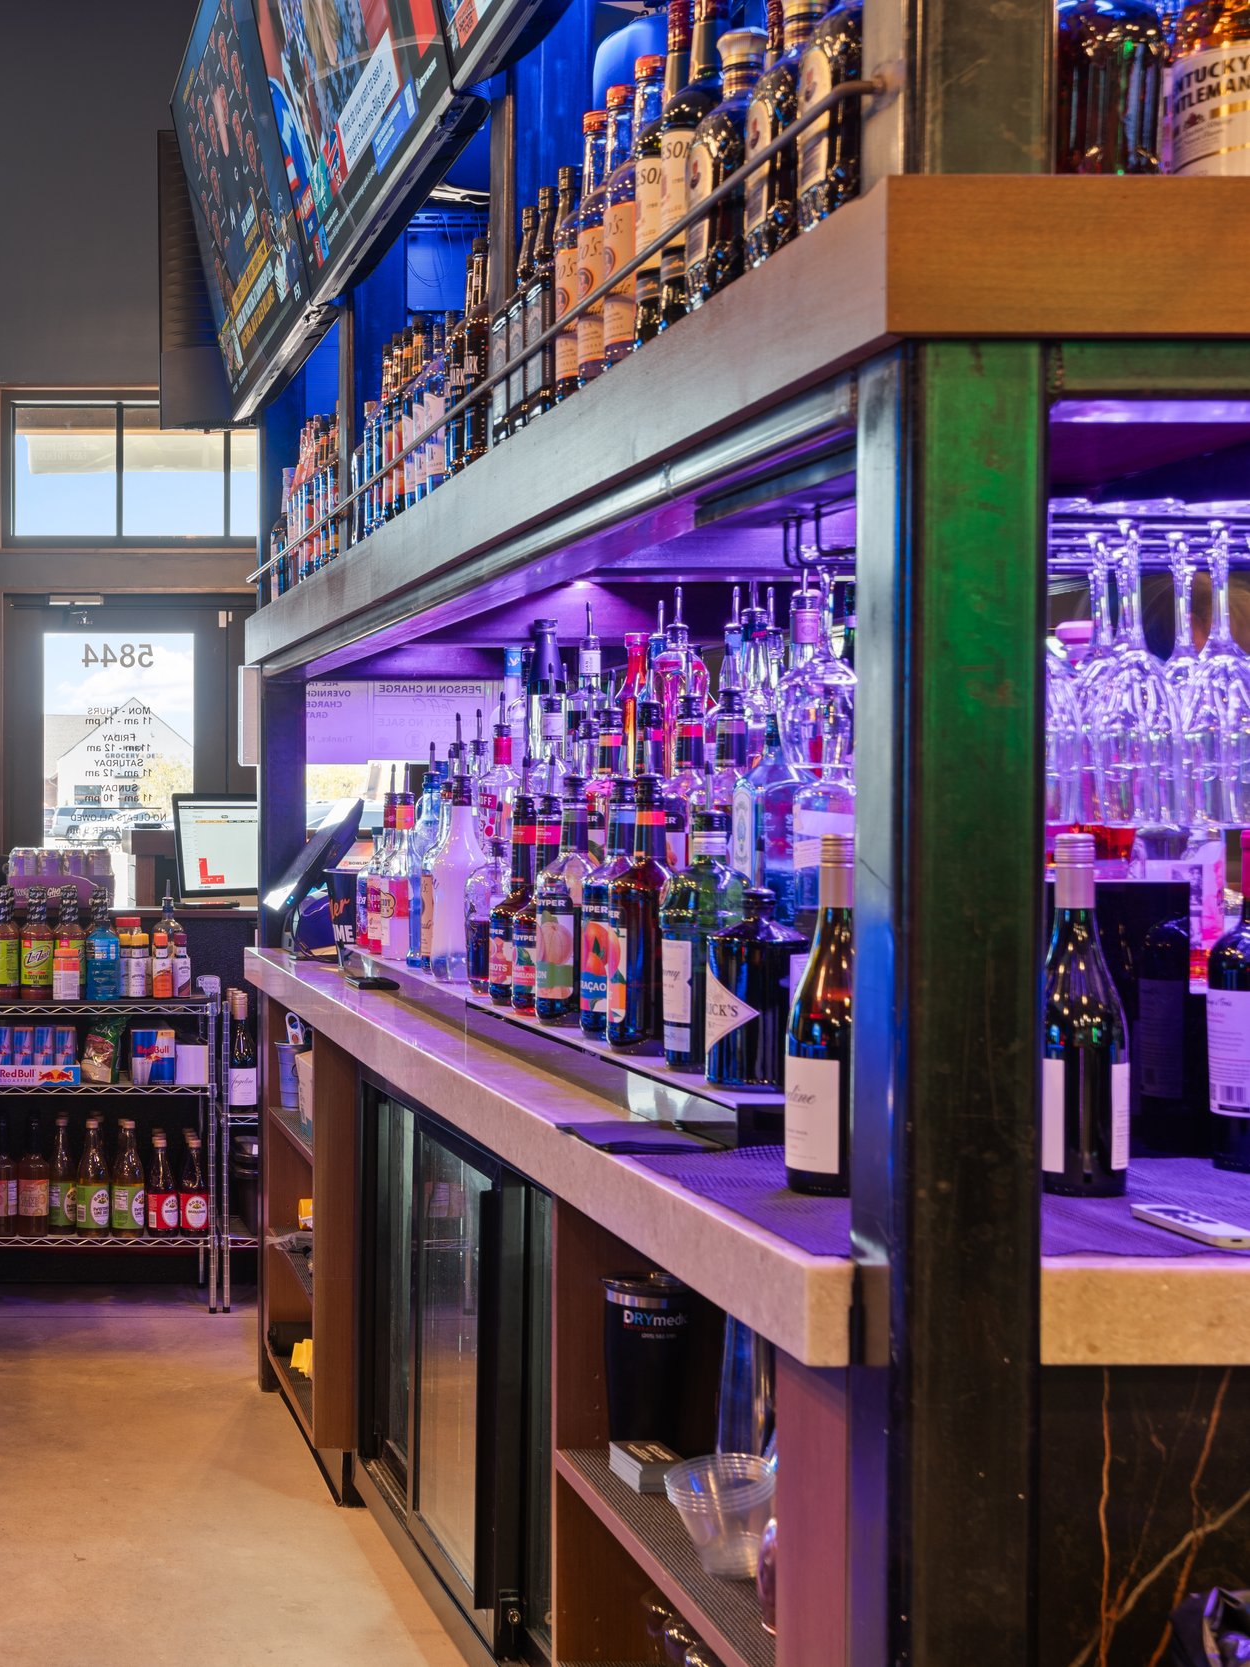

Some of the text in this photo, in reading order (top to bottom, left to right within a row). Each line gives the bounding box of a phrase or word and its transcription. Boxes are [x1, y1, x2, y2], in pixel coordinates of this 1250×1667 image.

[154, 1045, 170, 1054] Bull
[0, 1069, 35, 1078] Red Bull
